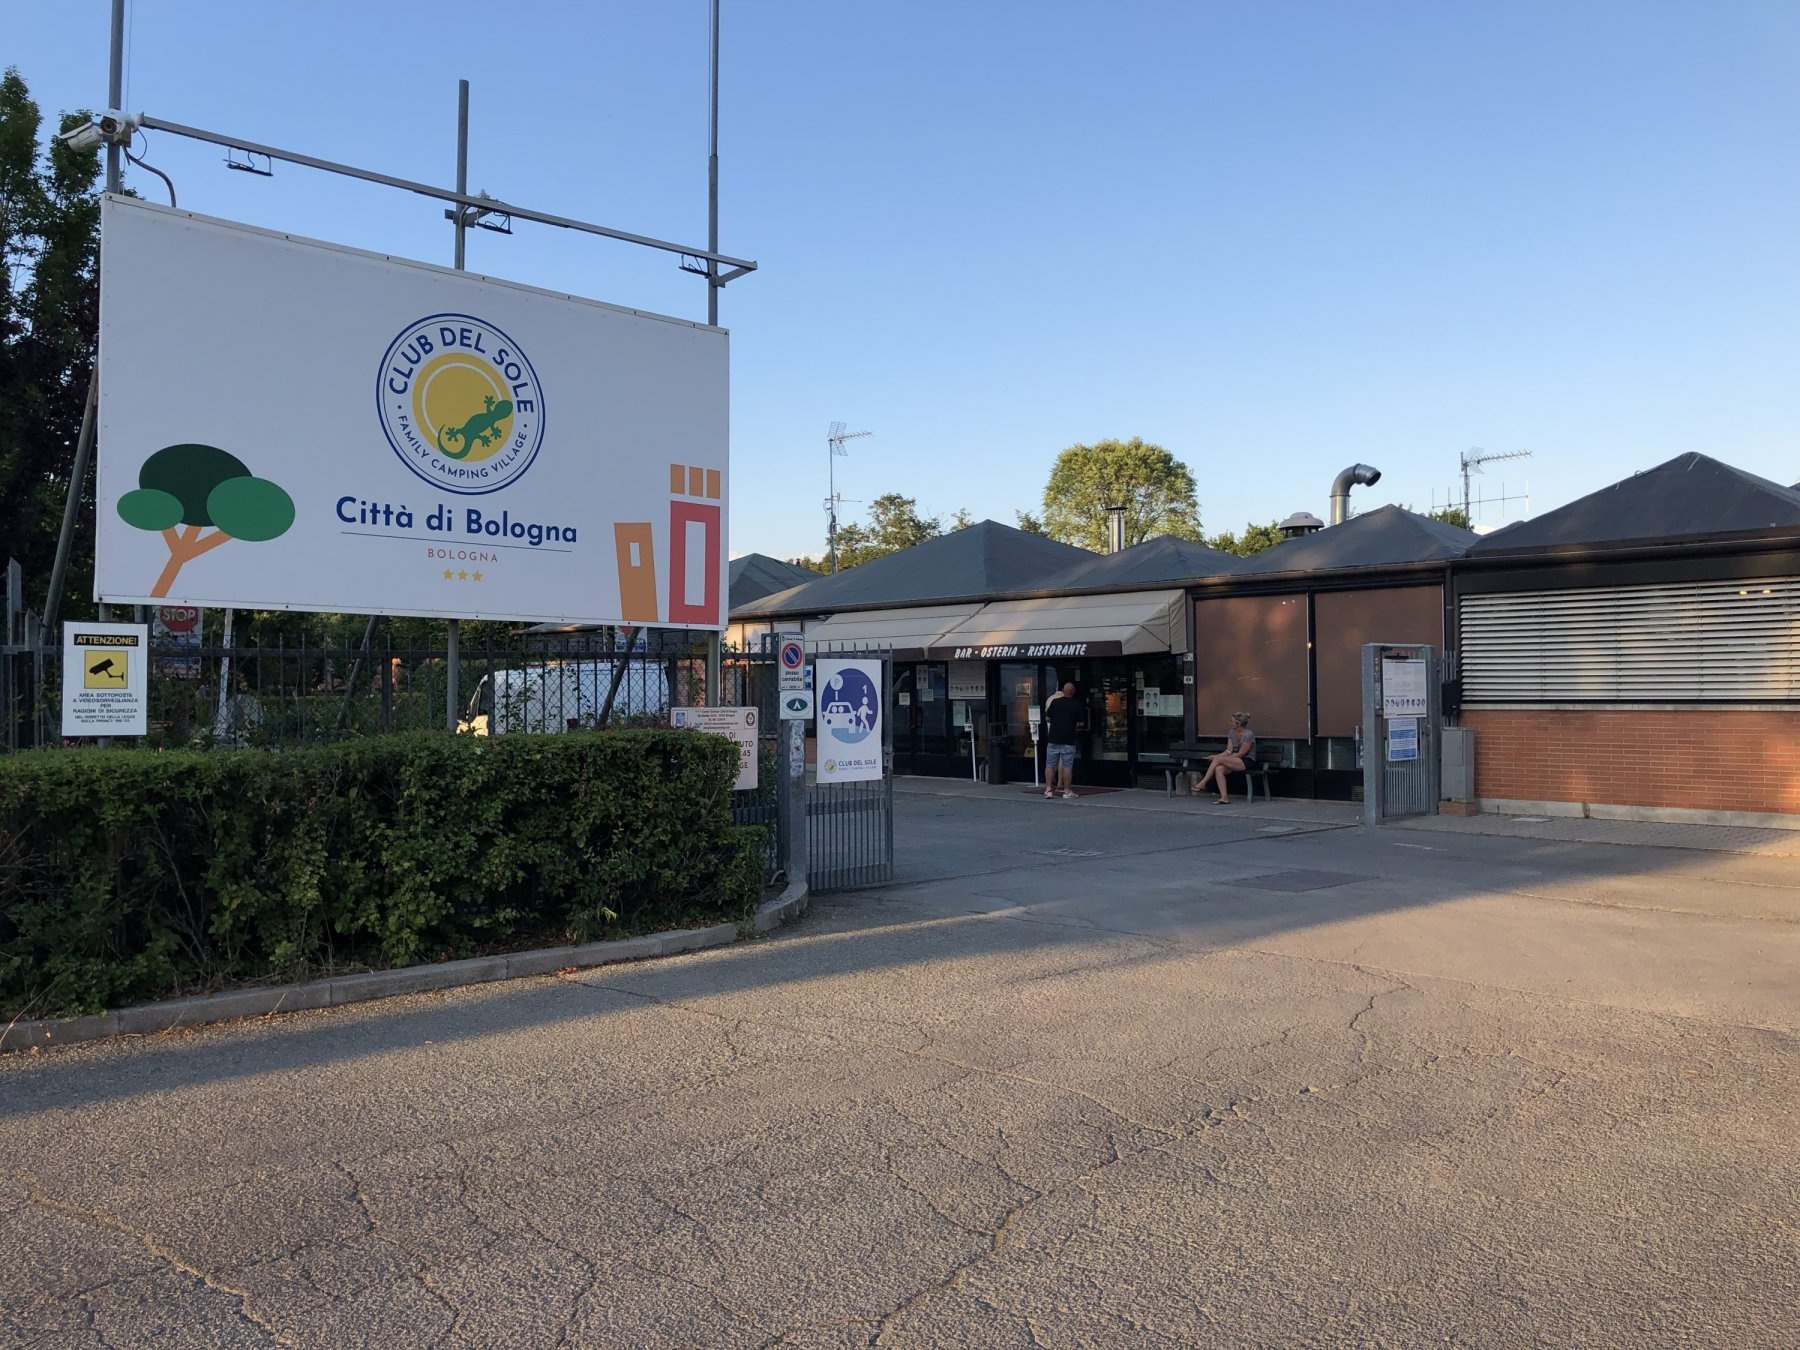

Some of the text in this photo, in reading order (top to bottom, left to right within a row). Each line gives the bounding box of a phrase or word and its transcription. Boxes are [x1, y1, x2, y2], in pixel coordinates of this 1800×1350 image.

[389, 327, 535, 414] CLUB DEL SOLE
[397, 415, 528, 480] FAMILY CAMPING VILLAGE
[336, 496, 577, 547] Città di Bologna
[428, 549, 498, 563] BOLOGNA
[162, 607, 196, 622] STOP
[76, 635, 137, 645] ATTENZIONE!
[954, 648, 972, 659] BAR
[980, 646, 1018, 658] OSTERIA
[1027, 644, 1087, 657] RISTORANTE
[834, 678, 840, 687] P
[862, 684, 867, 694] 1
[728, 731, 736, 739] DI
